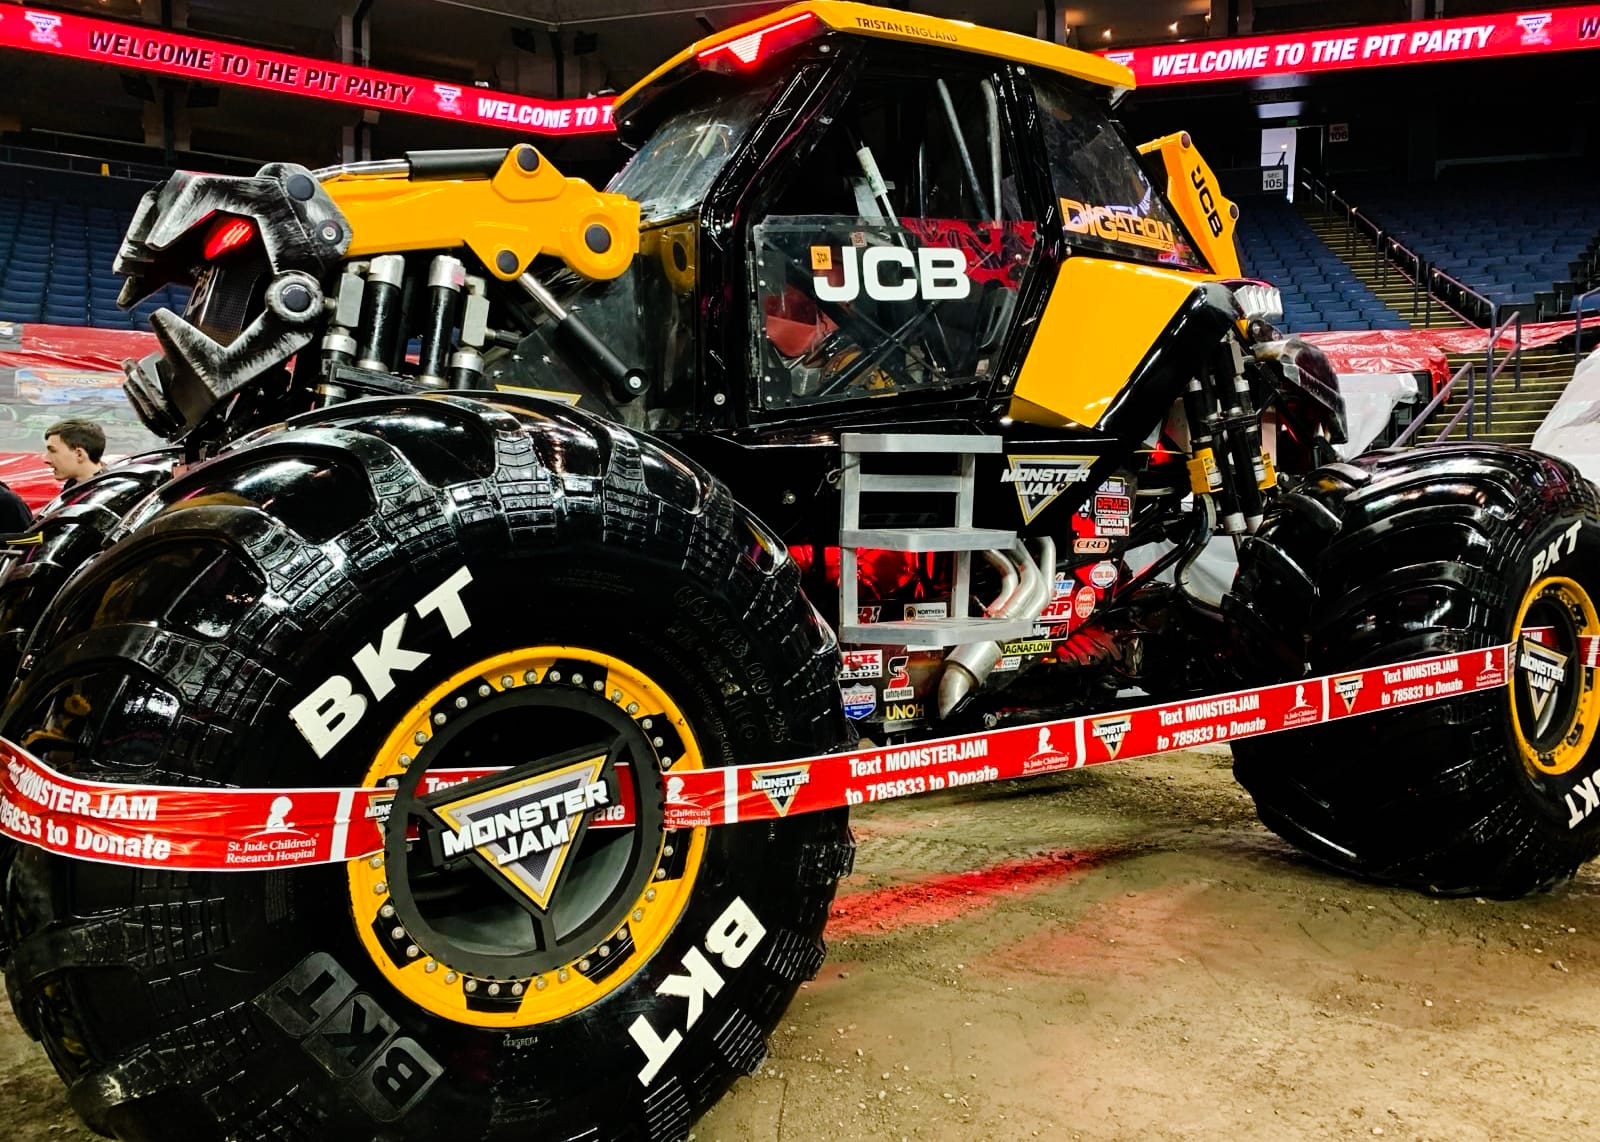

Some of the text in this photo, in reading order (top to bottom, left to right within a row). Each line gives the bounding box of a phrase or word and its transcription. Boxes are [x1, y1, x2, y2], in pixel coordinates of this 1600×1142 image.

[856, 17, 957, 42] TRISTAN ENGLAND
[1152, 46, 1268, 77] WELCOME
[1275, 43, 1306, 66] TO
[1312, 37, 1359, 62] THE
[1363, 33, 1407, 58] PIT
[1409, 25, 1495, 54] PARTY
[89, 30, 214, 71] WELCOME
[221, 53, 249, 75] TO
[256, 60, 299, 85] THE
[303, 68, 341, 92] PIT
[345, 76, 414, 105] PARTY
[478, 98, 571, 128] WELCOME
[575, 107, 598, 126] TO
[1263, 179, 1283, 189] 105
[1191, 165, 1223, 238] JCB
[811, 246, 970, 302] JCB
[1000, 469, 1091, 482] MONSTER
[1019, 482, 1060, 496] JAM
[1077, 541, 1108, 549] CRD
[1531, 520, 1582, 585] BKT
[288, 566, 474, 760] BKT
[1383, 669, 1402, 685] Text
[1403, 658, 1459, 681] MONSTERJAM
[1521, 654, 1565, 682] MONSTER
[1381, 691, 1391, 705] to
[1392, 687, 1424, 703] 785833
[1425, 683, 1434, 696] to
[1435, 678, 1463, 695] Donate
[1532, 673, 1552, 692] JAM
[886, 704, 924, 720] UNOH
[1159, 694, 1260, 727] Text MONSTERJAM
[1092, 722, 1131, 737] MONSTER
[1105, 733, 1122, 743] JAM
[1157, 717, 1266, 750] to 785833 to Donate
[849, 739, 987, 777] Text MONSTERJAM
[16, 767, 158, 821] MONSTERJAM
[752, 774, 809, 790] MONSTER
[769, 787, 797, 797] JAM
[845, 765, 999, 805] to 785833 to Donate
[442, 780, 609, 857] MONSTER
[670, 808, 711, 818] Children's
[676, 817, 711, 826] Hospital
[47, 818, 69, 846] to
[75, 825, 171, 861] Donate
[228, 838, 317, 854] St. Jude Children's
[497, 819, 569, 865] JAM
[226, 848, 315, 864] Research Hospital
[628, 896, 767, 1086] BKT
[272, 966, 435, 1113] BKT
